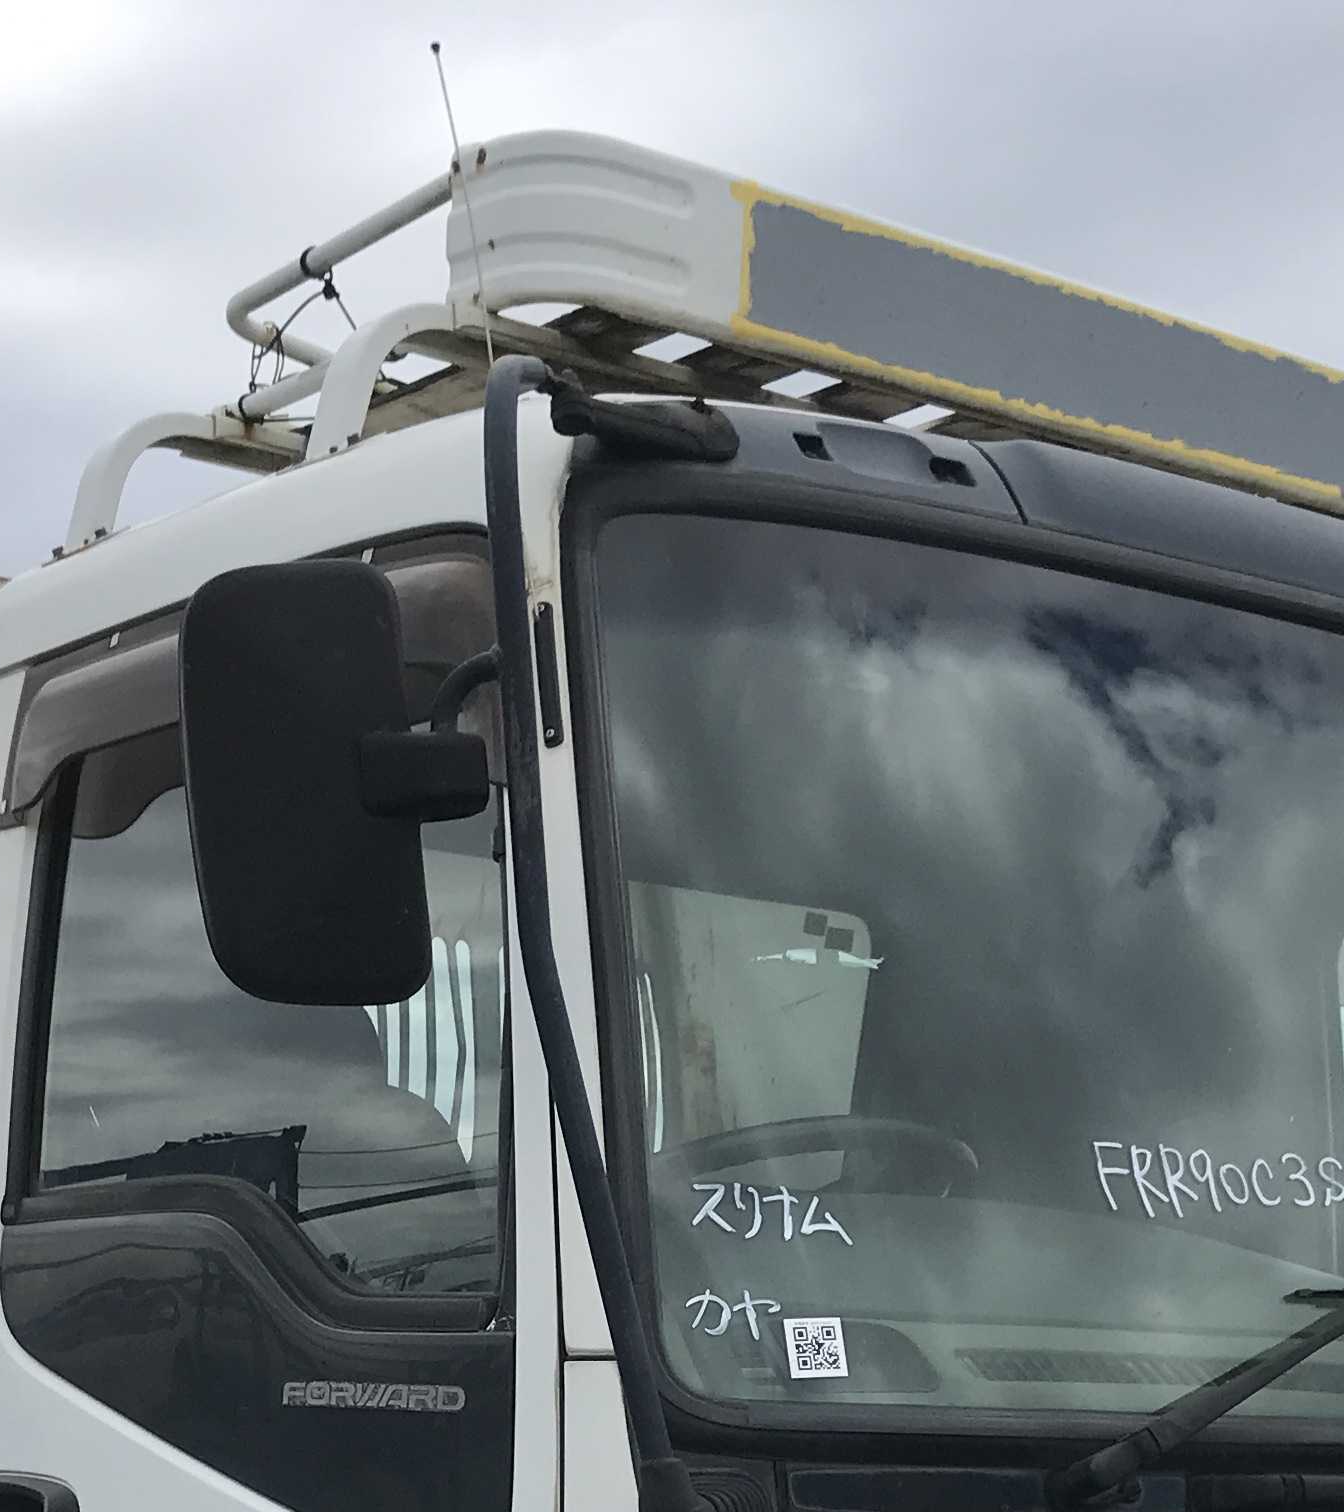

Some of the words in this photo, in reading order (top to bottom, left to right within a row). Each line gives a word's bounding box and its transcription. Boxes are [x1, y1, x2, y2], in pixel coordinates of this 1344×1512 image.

[692, 1182, 854, 1246] スリナム
[685, 1288, 781, 1341] カヤ
[282, 1381, 466, 1411] FORWARD
